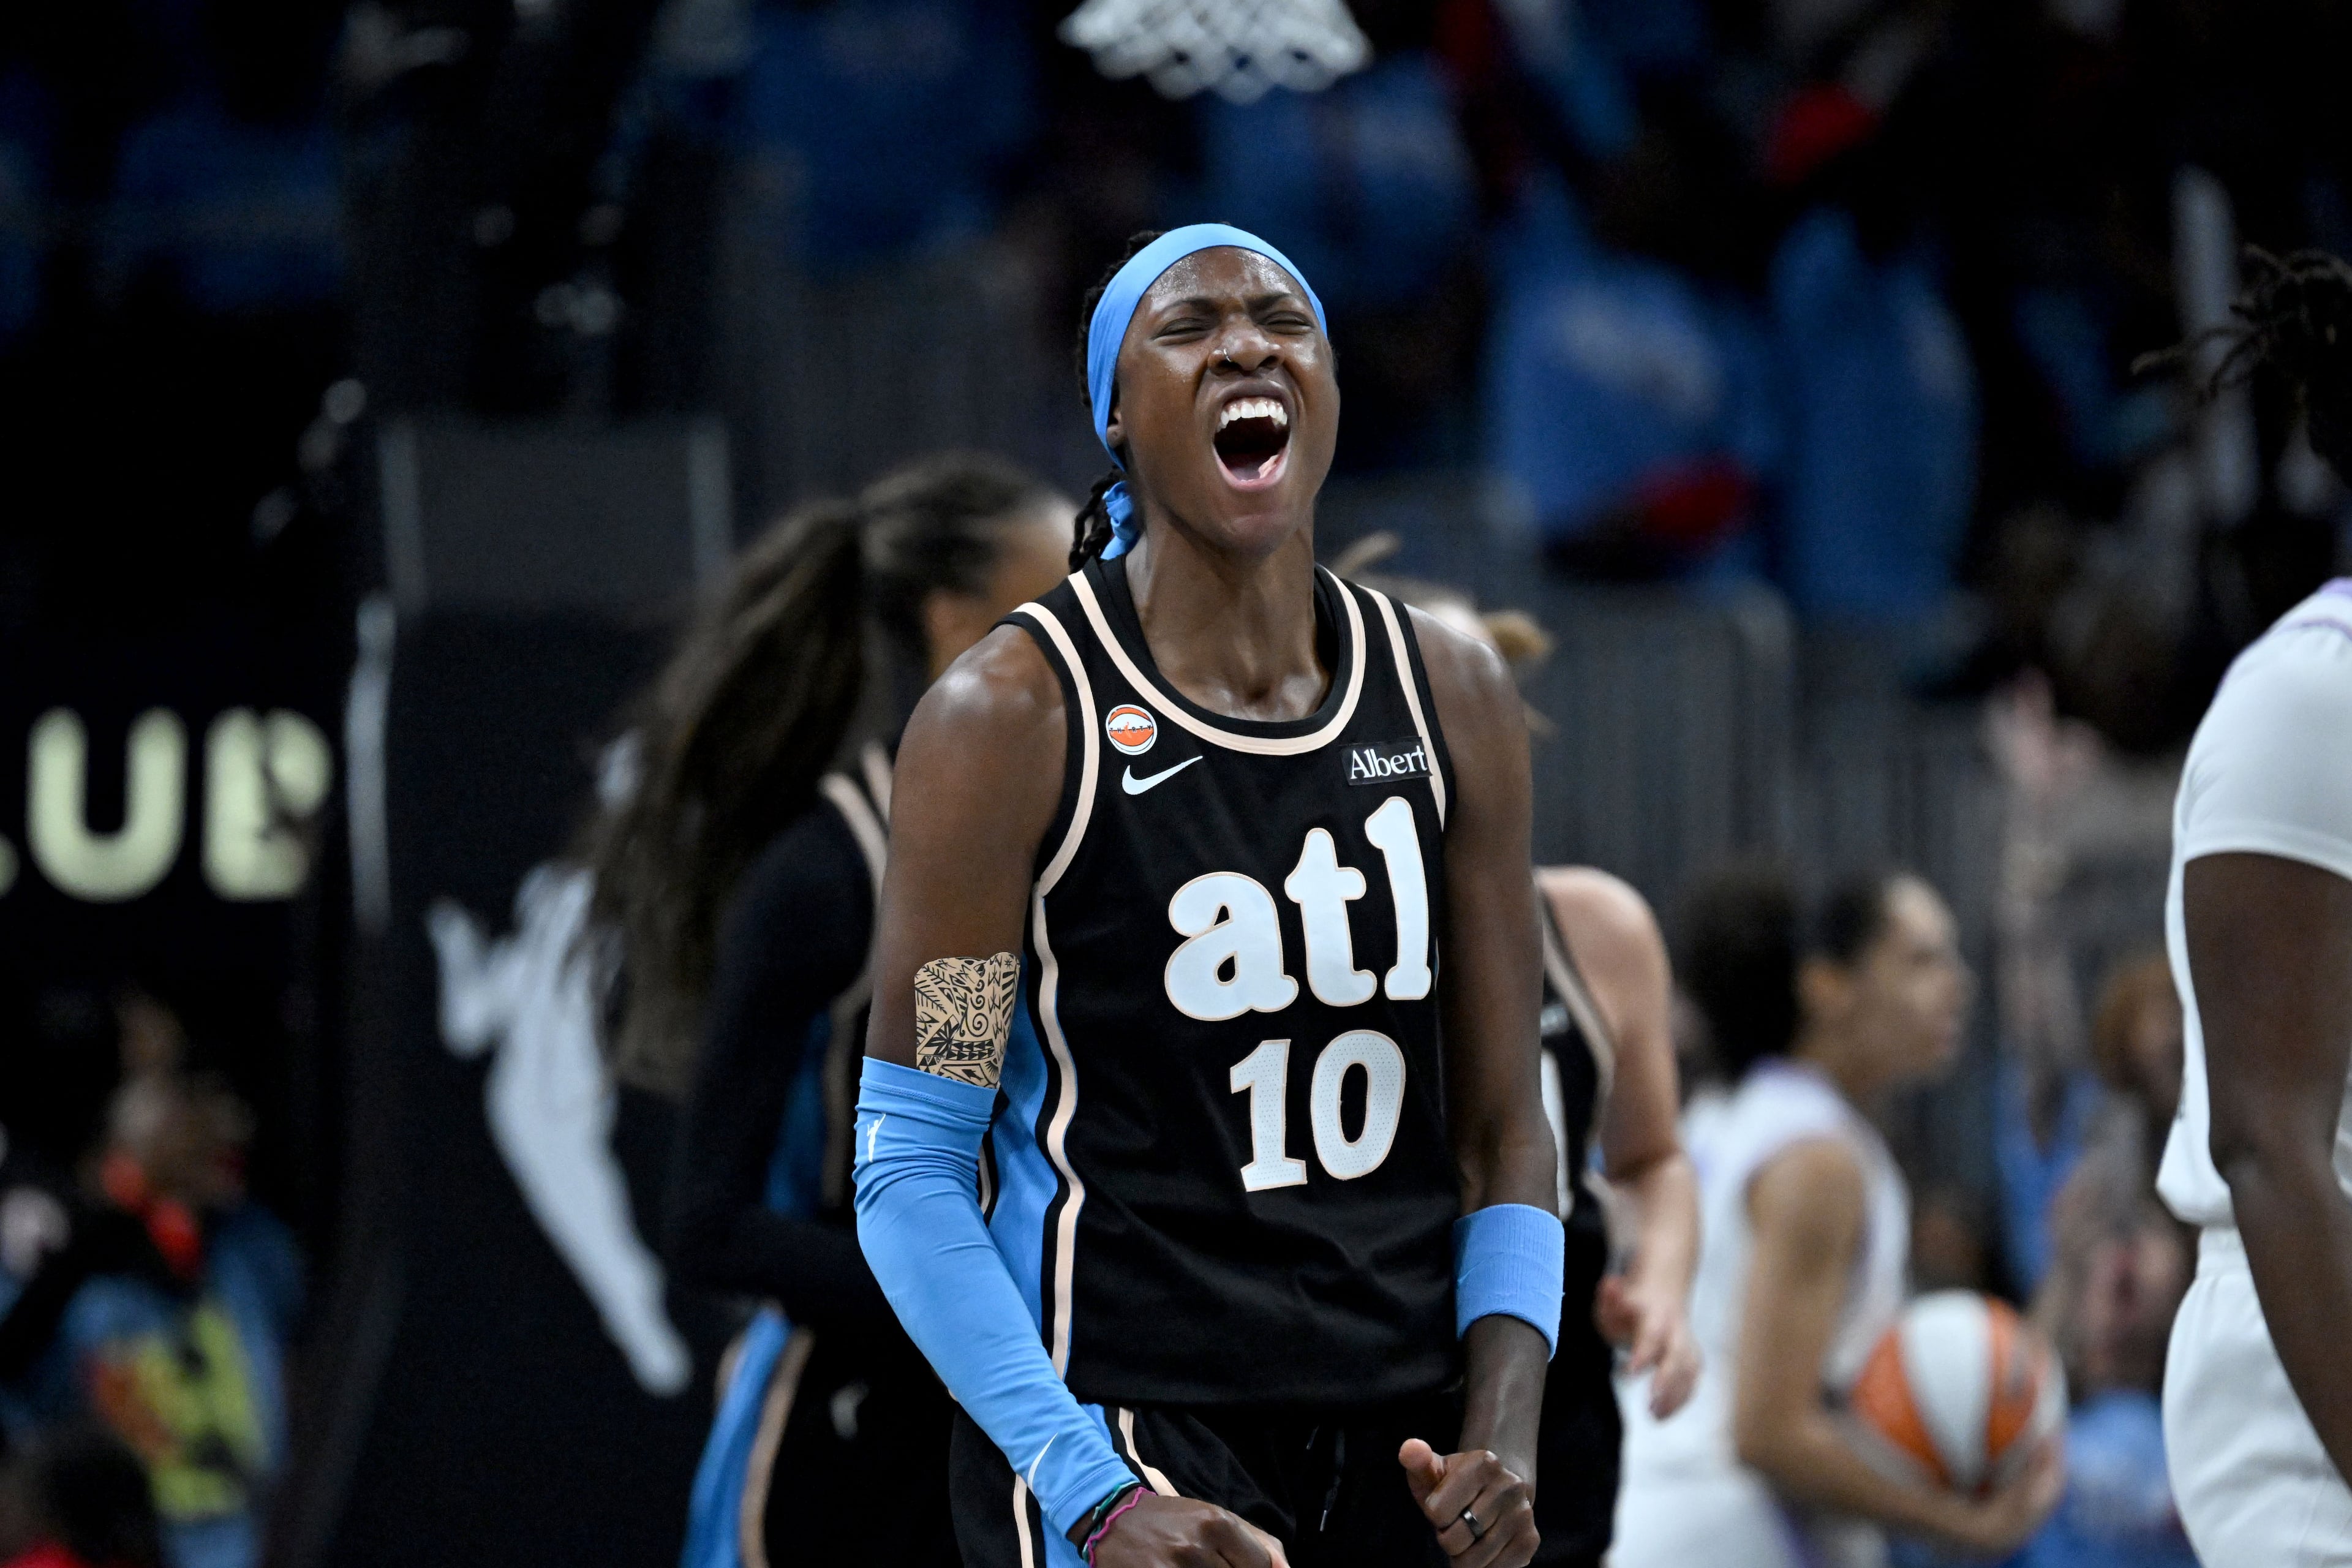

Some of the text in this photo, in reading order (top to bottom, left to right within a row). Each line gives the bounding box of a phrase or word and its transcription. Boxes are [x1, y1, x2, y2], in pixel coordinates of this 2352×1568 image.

[0, 704, 334, 904] UB
[1350, 745, 1428, 780] Albert
[1165, 796, 1431, 1021] atl
[1230, 1030, 1406, 1192] 10
